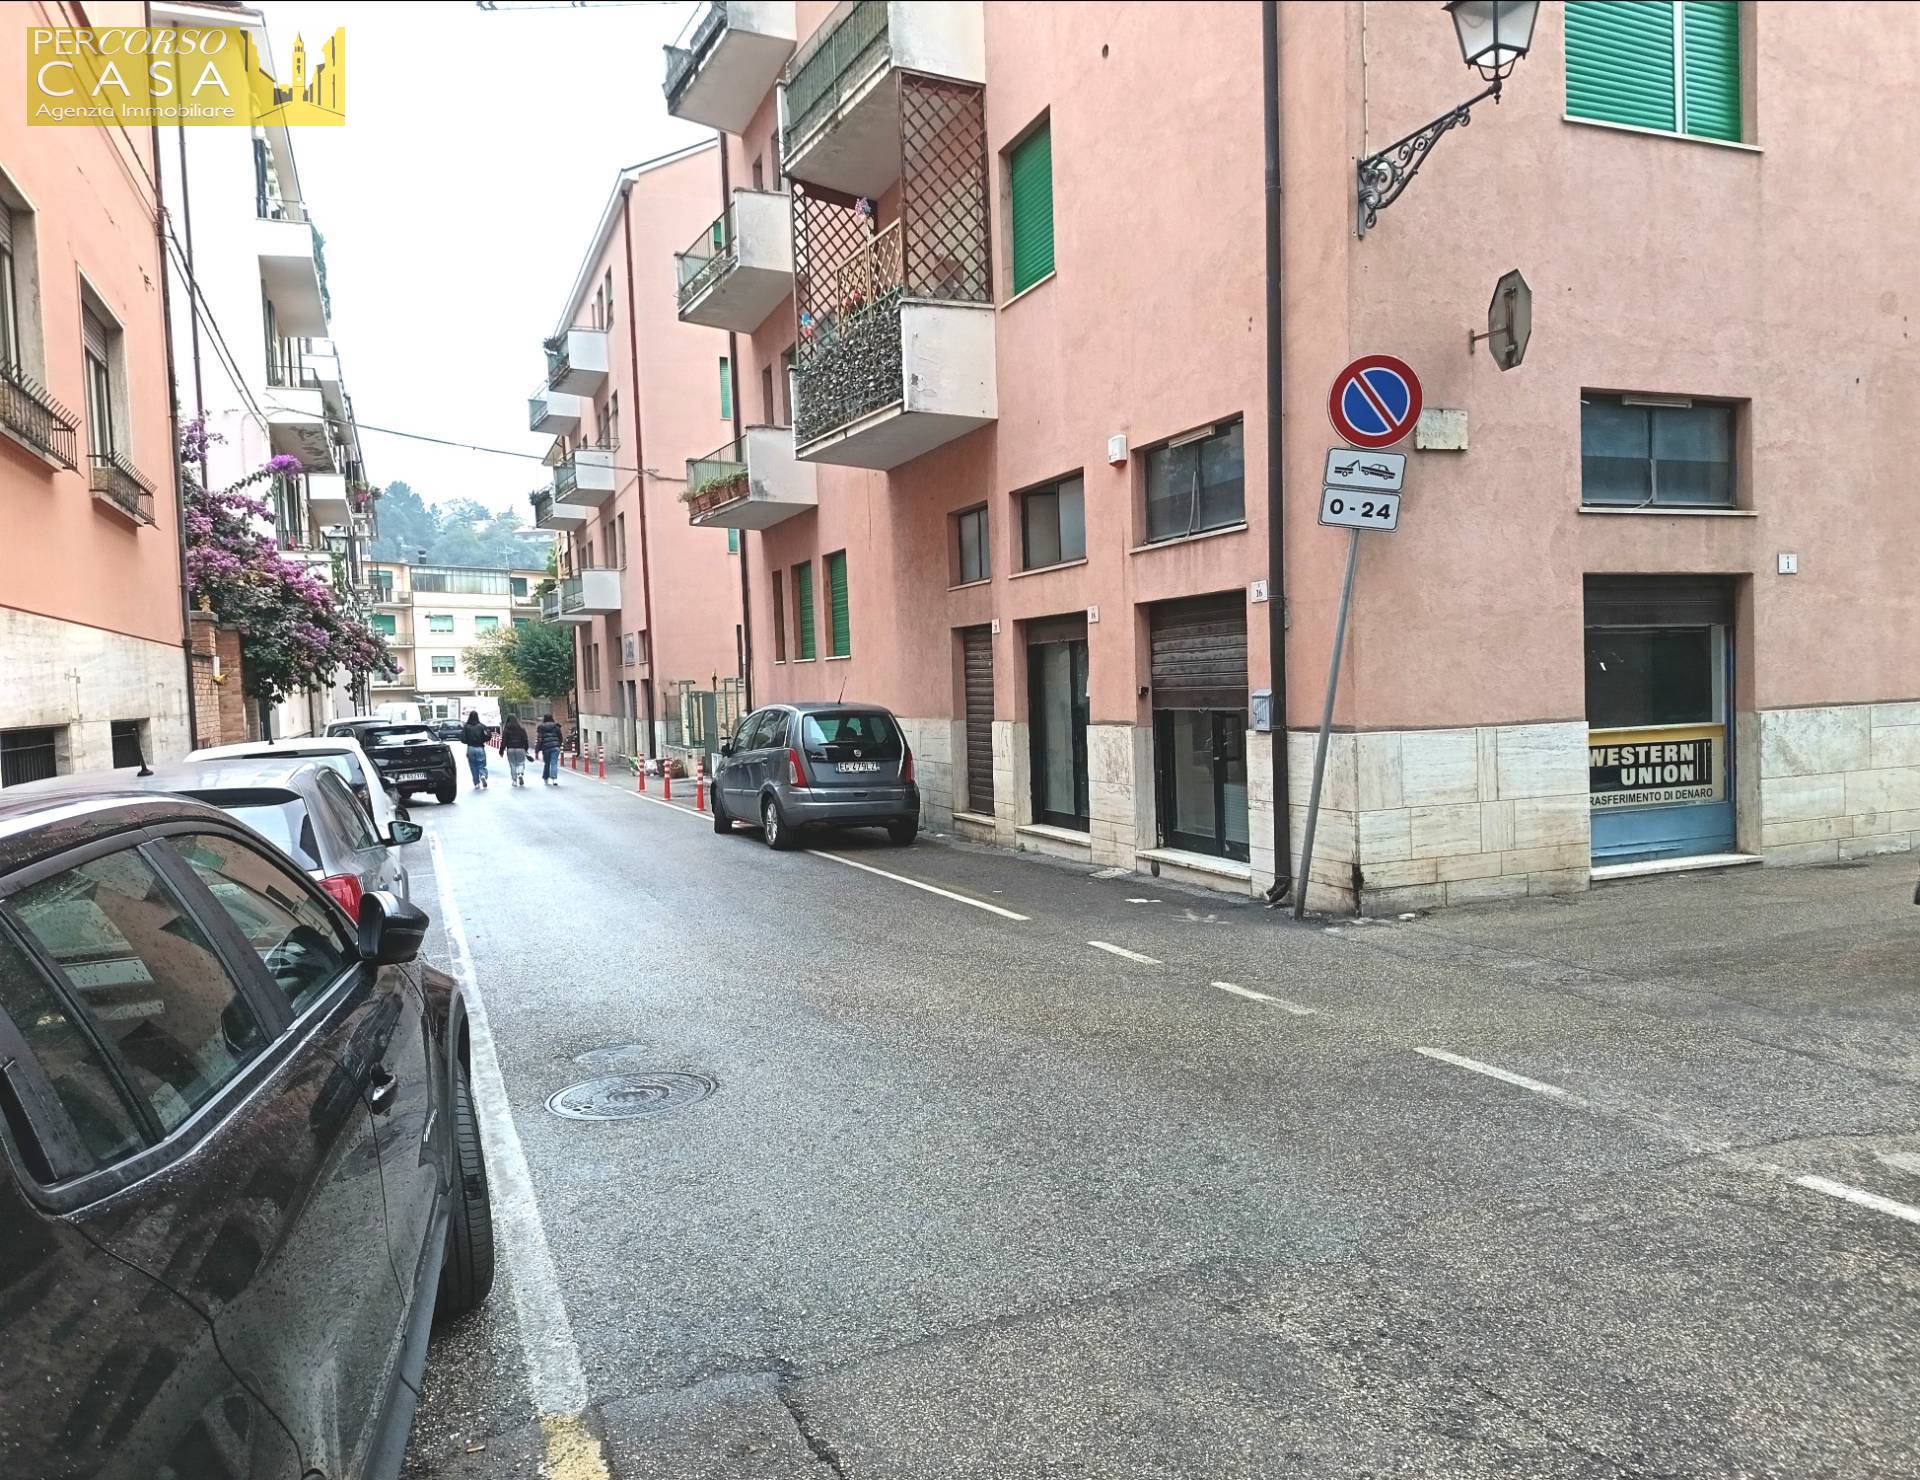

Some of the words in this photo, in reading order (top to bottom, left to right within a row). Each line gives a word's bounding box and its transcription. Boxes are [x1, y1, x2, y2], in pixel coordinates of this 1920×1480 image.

[1361, 501, 1391, 520] 24
[1255, 588, 1263, 598] 16
[1589, 743, 1694, 768] WESTERN
[1620, 763, 1694, 786] UNION
[1589, 791, 1662, 806] RASFERIMENTO
[1664, 790, 1673, 801] DI
[1675, 787, 1713, 799] DENARO
